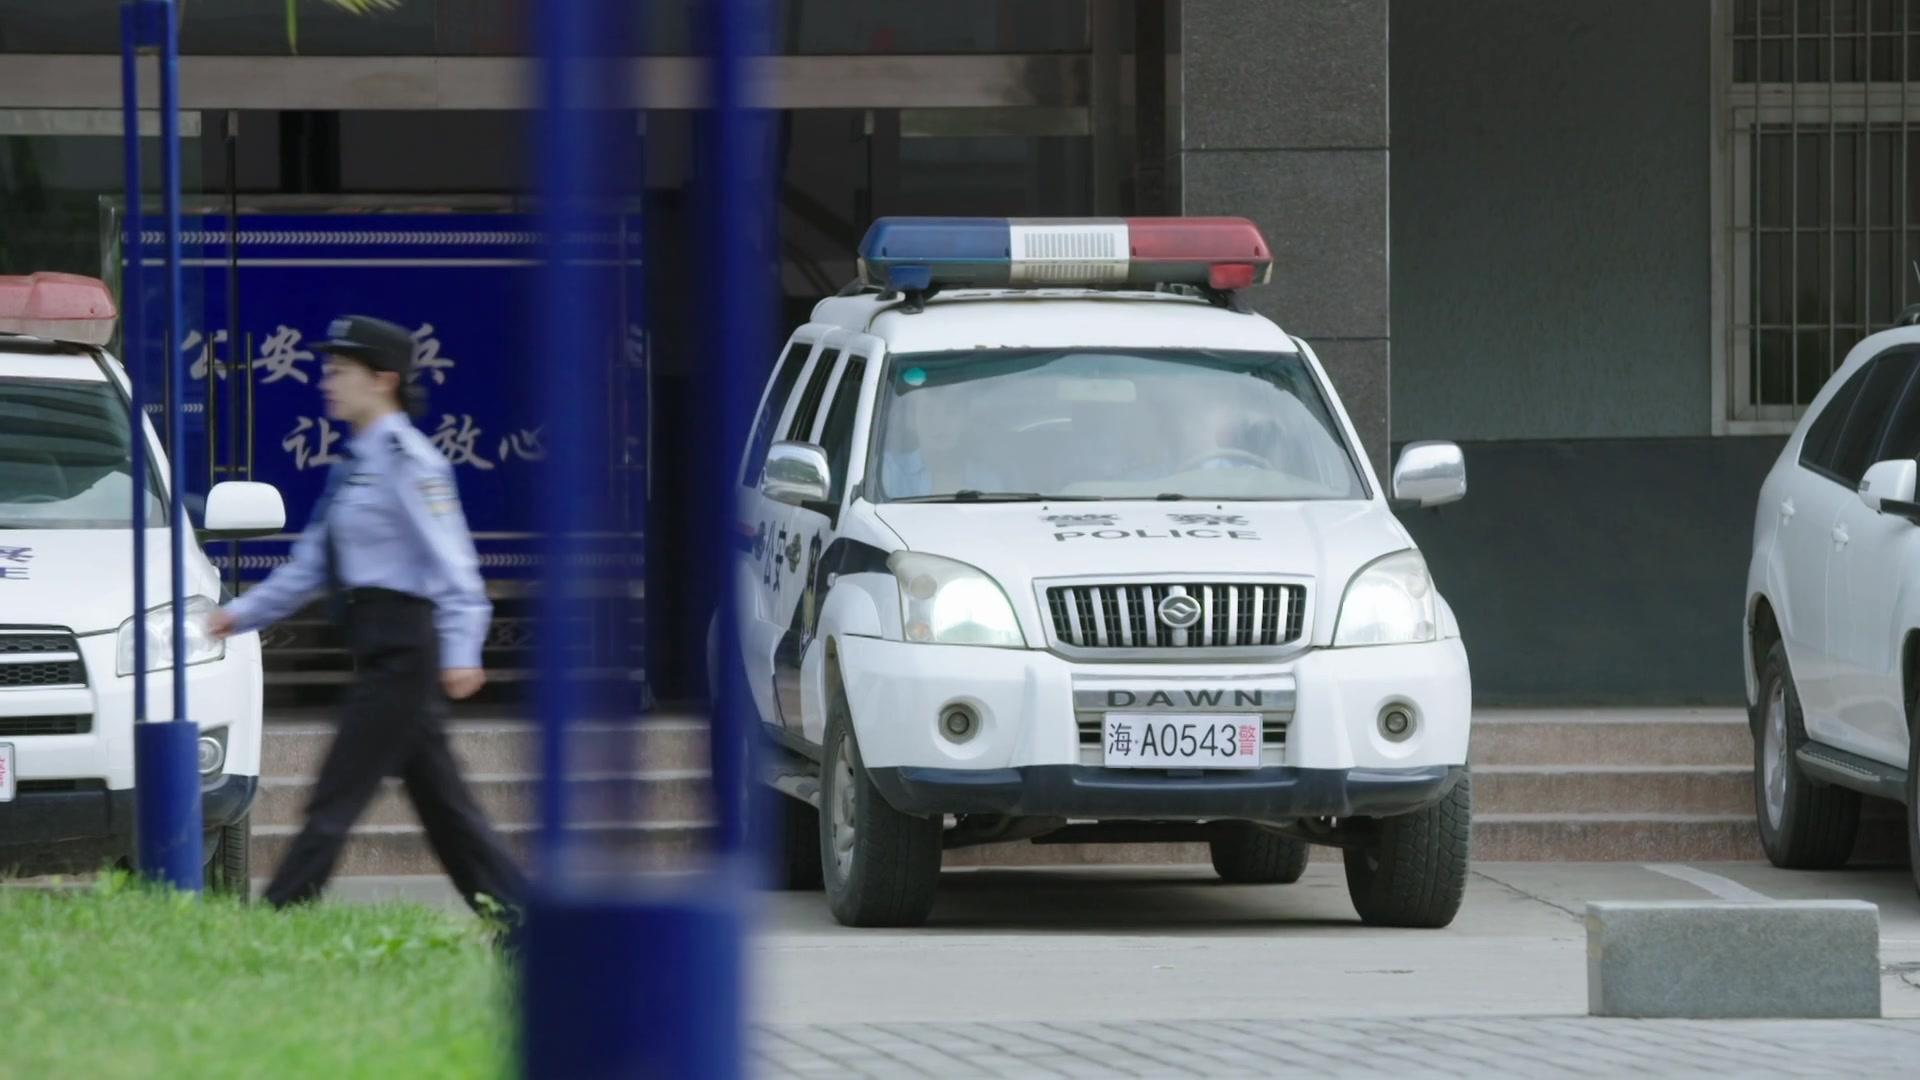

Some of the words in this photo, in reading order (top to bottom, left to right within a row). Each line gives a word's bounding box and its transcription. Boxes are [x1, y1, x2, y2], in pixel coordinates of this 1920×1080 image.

[181, 323, 455, 382] 公安兵
[282, 413, 545, 470] 让放心
[1053, 529, 1262, 541] POLICE
[1106, 689, 1264, 707] DAWN
